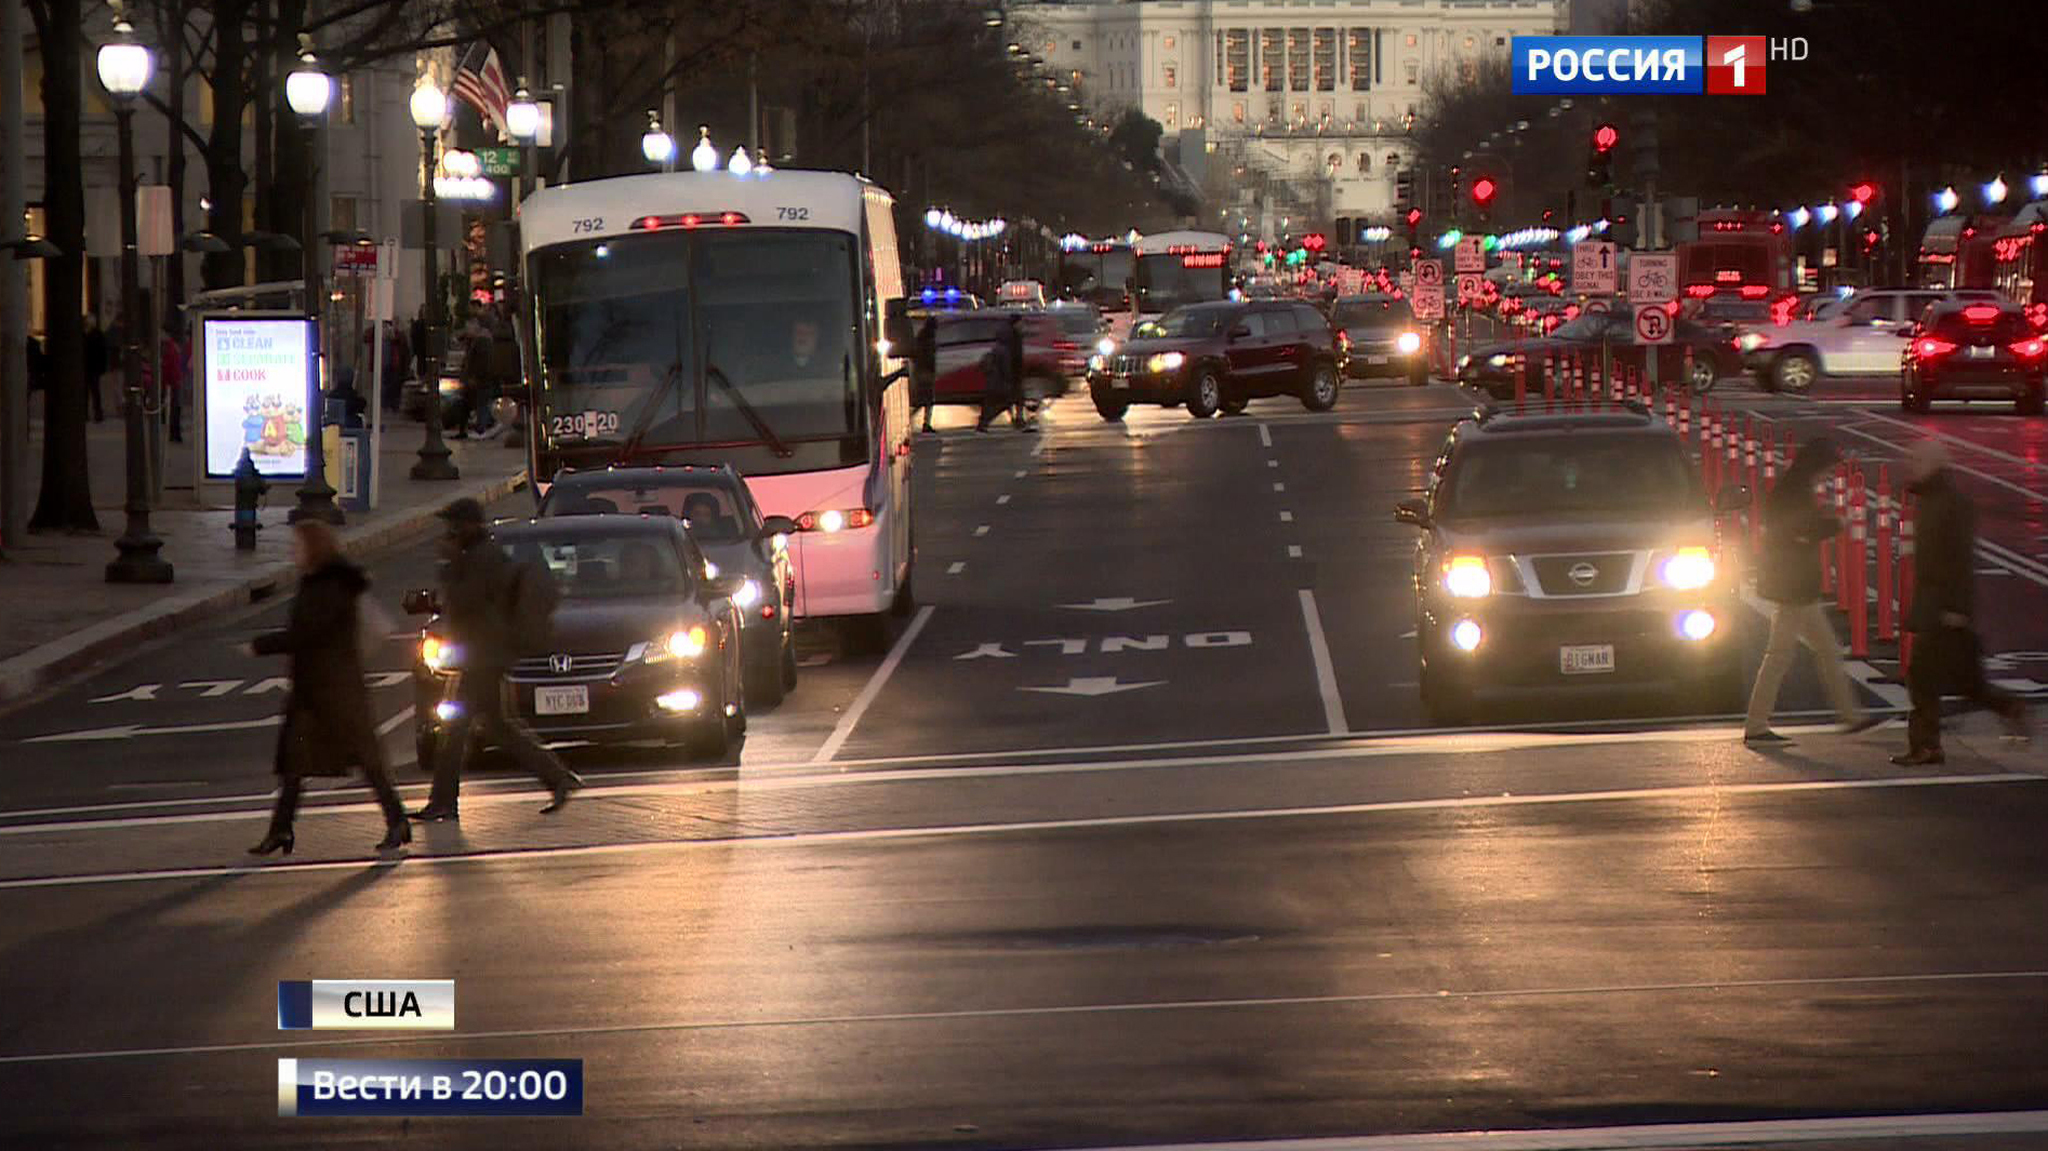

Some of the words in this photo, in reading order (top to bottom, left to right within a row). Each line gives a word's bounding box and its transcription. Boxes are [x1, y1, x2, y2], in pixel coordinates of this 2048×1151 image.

[776, 207, 809, 221] 792
[572, 218, 604, 233] 792
[232, 336, 273, 350] CLEAN
[232, 368, 267, 381] COOK
[952, 631, 1252, 661] ONLY
